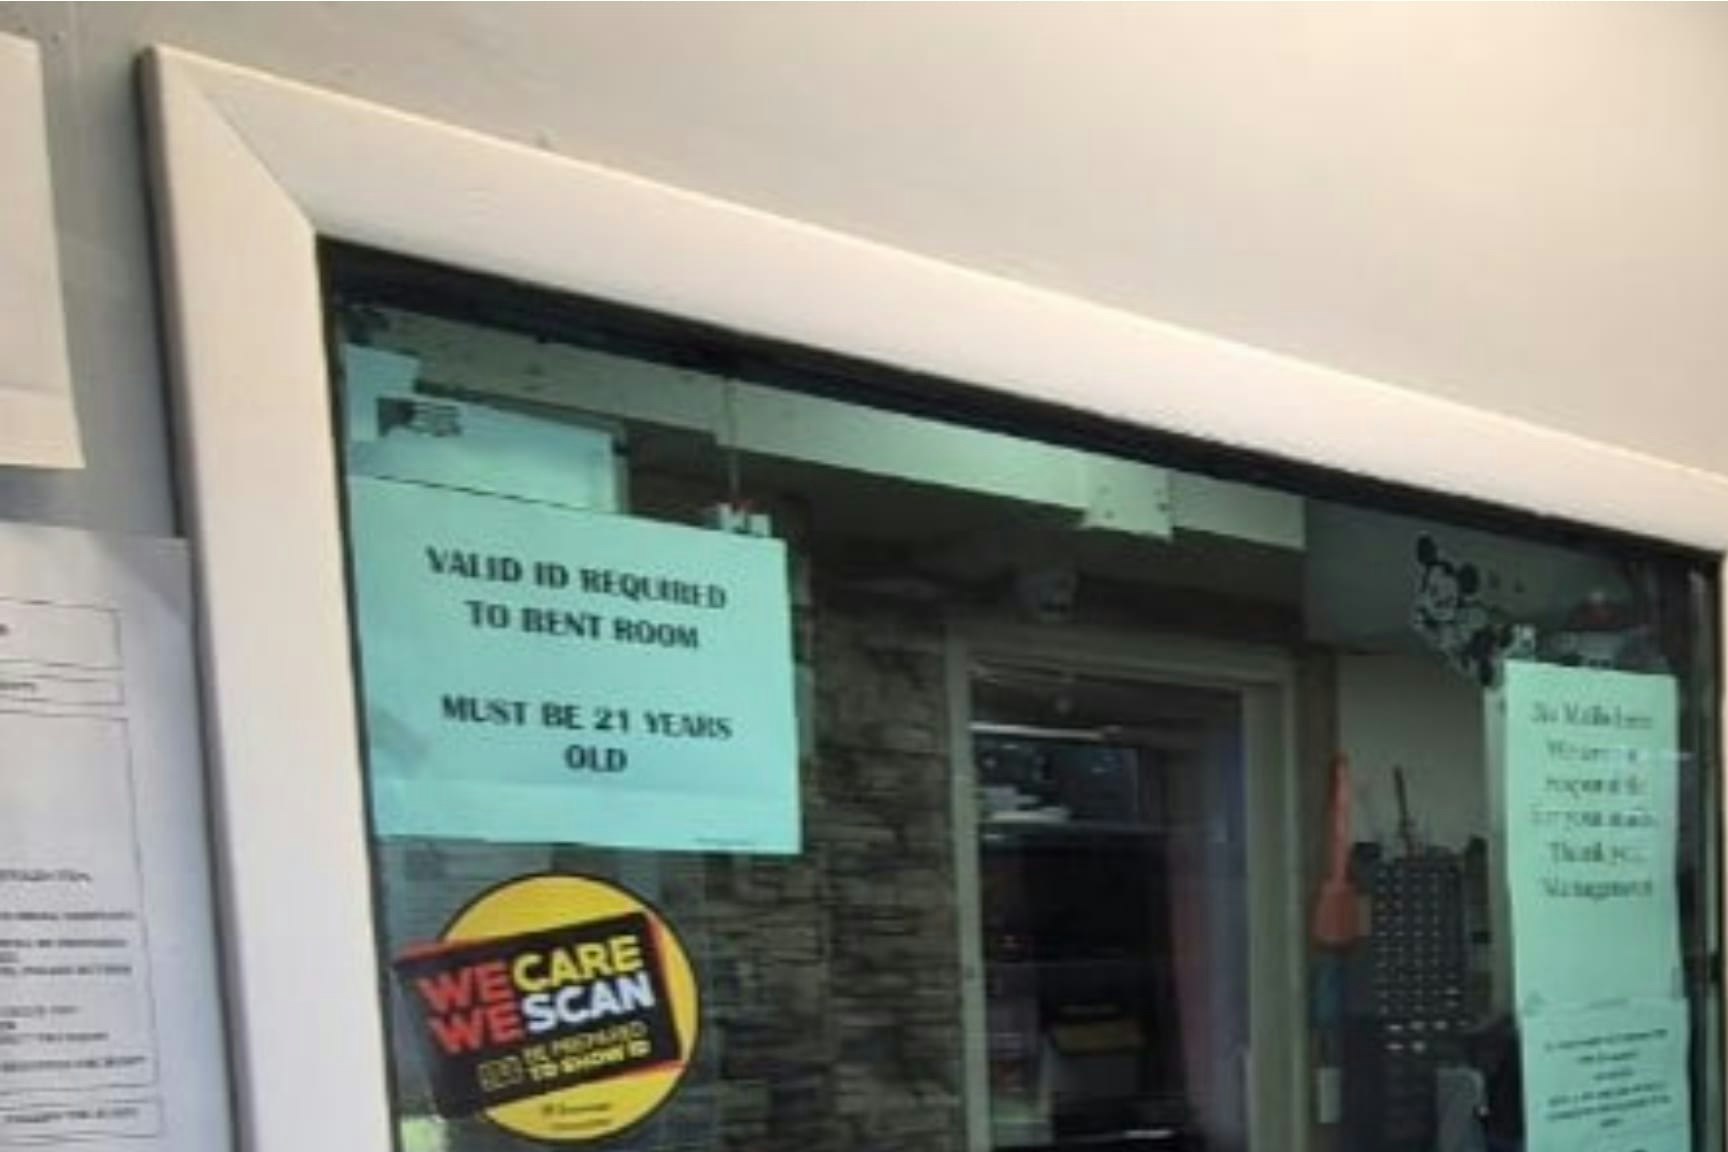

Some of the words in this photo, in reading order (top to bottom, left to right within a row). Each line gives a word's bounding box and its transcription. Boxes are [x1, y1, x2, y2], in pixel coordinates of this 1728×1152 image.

[424, 545, 523, 584] VALID
[533, 558, 570, 591] ID
[580, 567, 727, 608] REQUIRED
[463, 600, 510, 631] TO
[520, 605, 603, 639] RENT
[614, 617, 699, 649] ROOM
[442, 695, 531, 726] MUST
[541, 702, 582, 731] BE
[592, 705, 632, 733] 21
[642, 710, 734, 740] YEARS
[563, 742, 629, 774] OLD
[418, 962, 513, 1010] WE
[513, 936, 644, 991] CARE
[428, 1005, 522, 1054] WE
[522, 973, 656, 1032] SCAN
